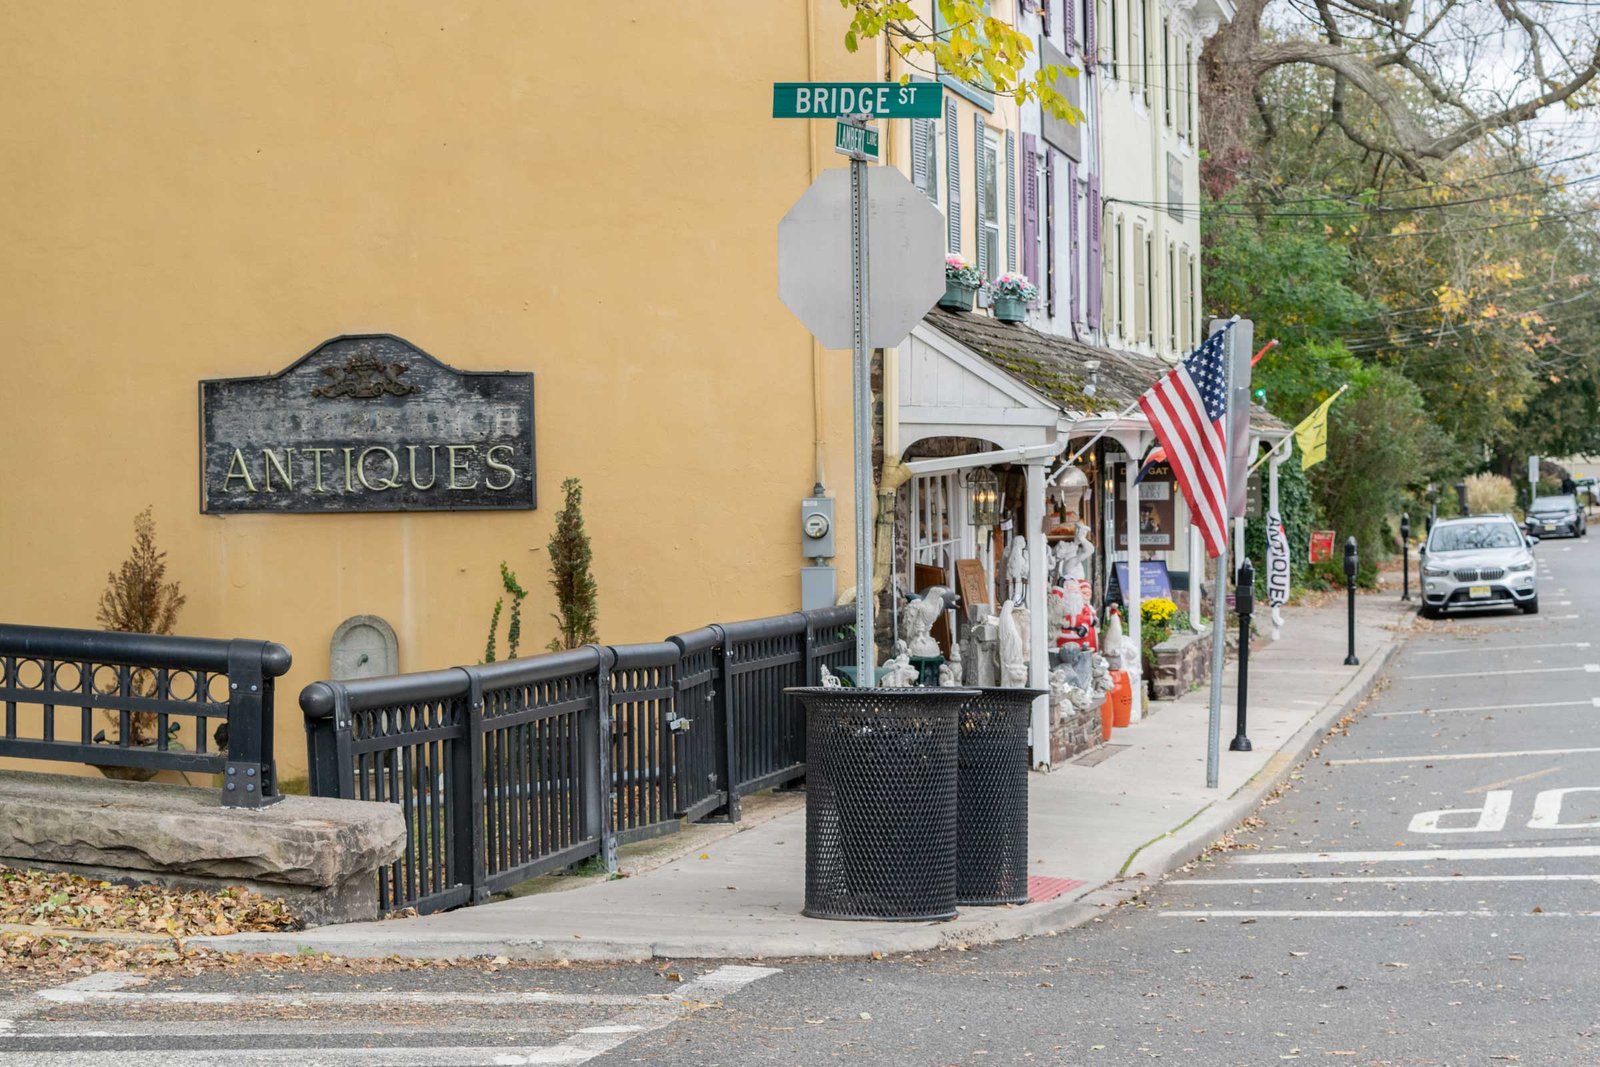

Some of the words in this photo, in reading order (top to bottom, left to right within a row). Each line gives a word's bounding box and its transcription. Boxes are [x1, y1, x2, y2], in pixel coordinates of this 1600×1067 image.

[796, 88, 890, 114] BRIDGE
[898, 87, 917, 105] ST
[837, 126, 865, 153] LAMBERT
[866, 130, 878, 147] LANE
[220, 444, 517, 494] ANTIQUES
